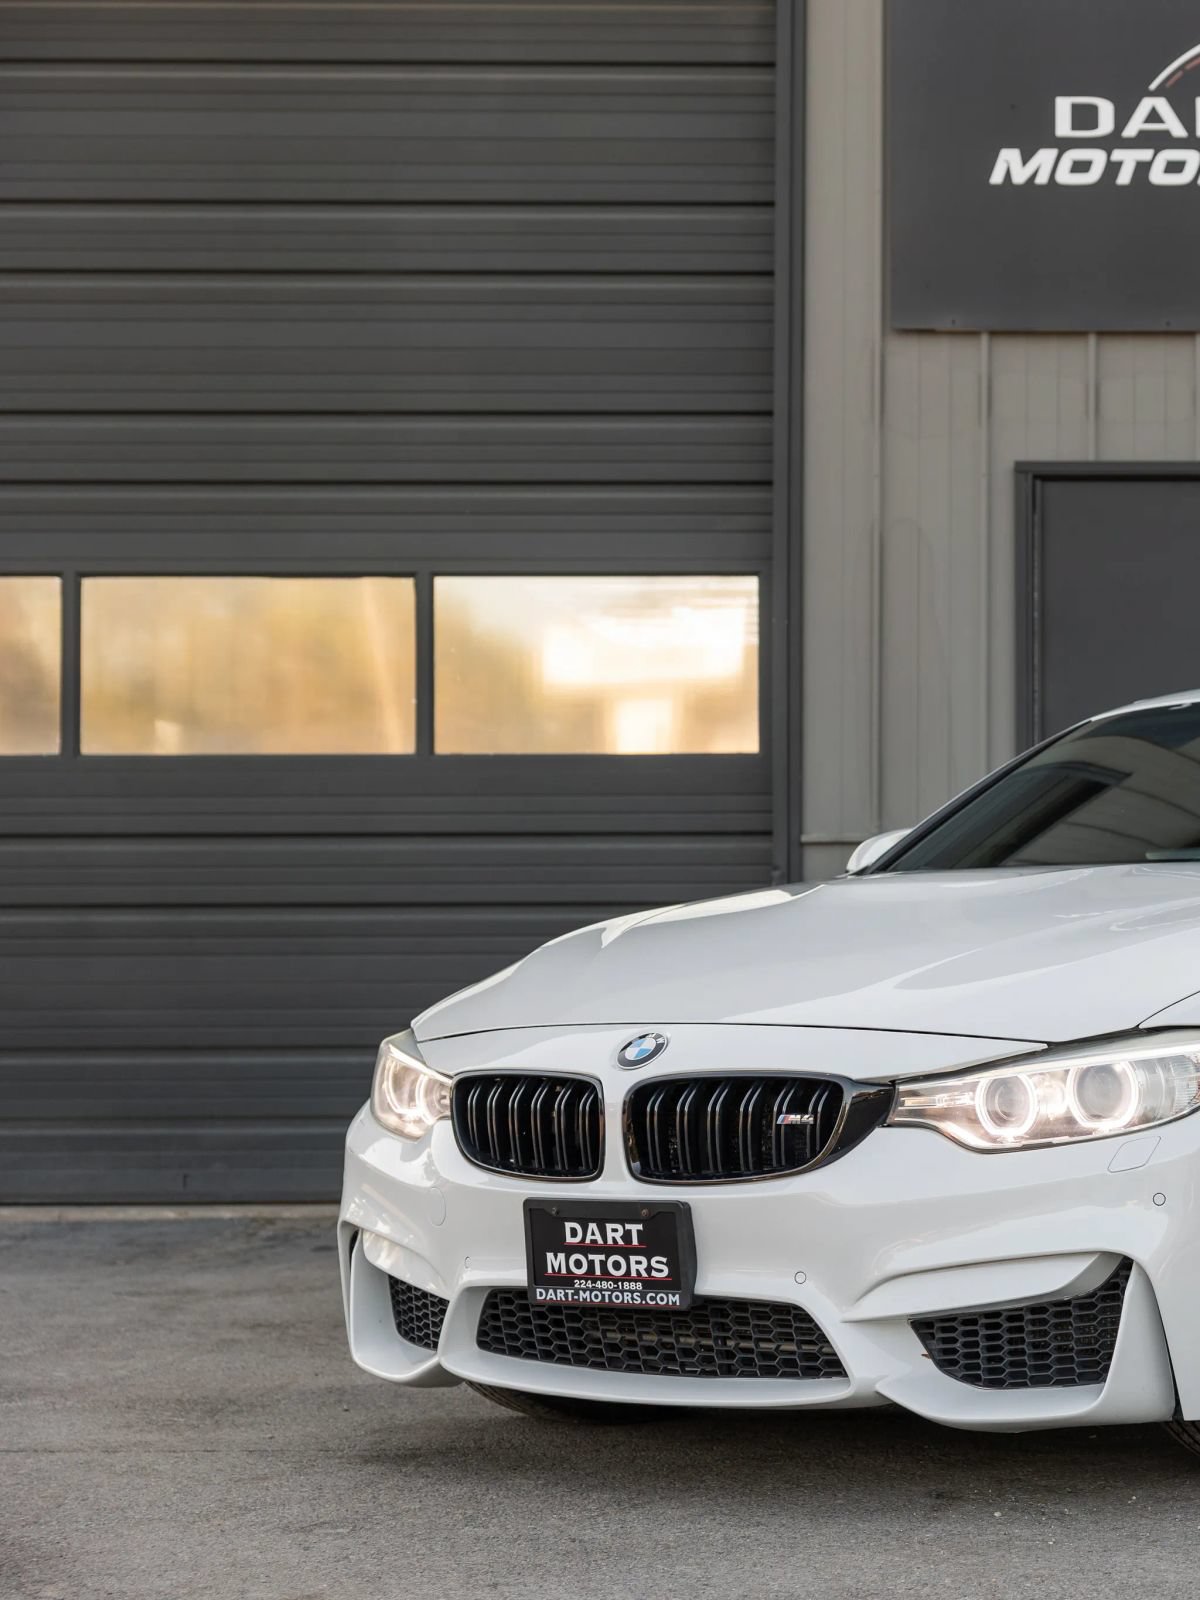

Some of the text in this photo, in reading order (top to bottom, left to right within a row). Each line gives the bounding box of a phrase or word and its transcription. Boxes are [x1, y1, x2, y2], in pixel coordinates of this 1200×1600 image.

[563, 1221, 644, 1246] DART
[545, 1252, 670, 1278] MOTORS
[573, 1279, 643, 1290] 224-480-1888
[535, 1288, 681, 1306] DART-MOTORS.COM
